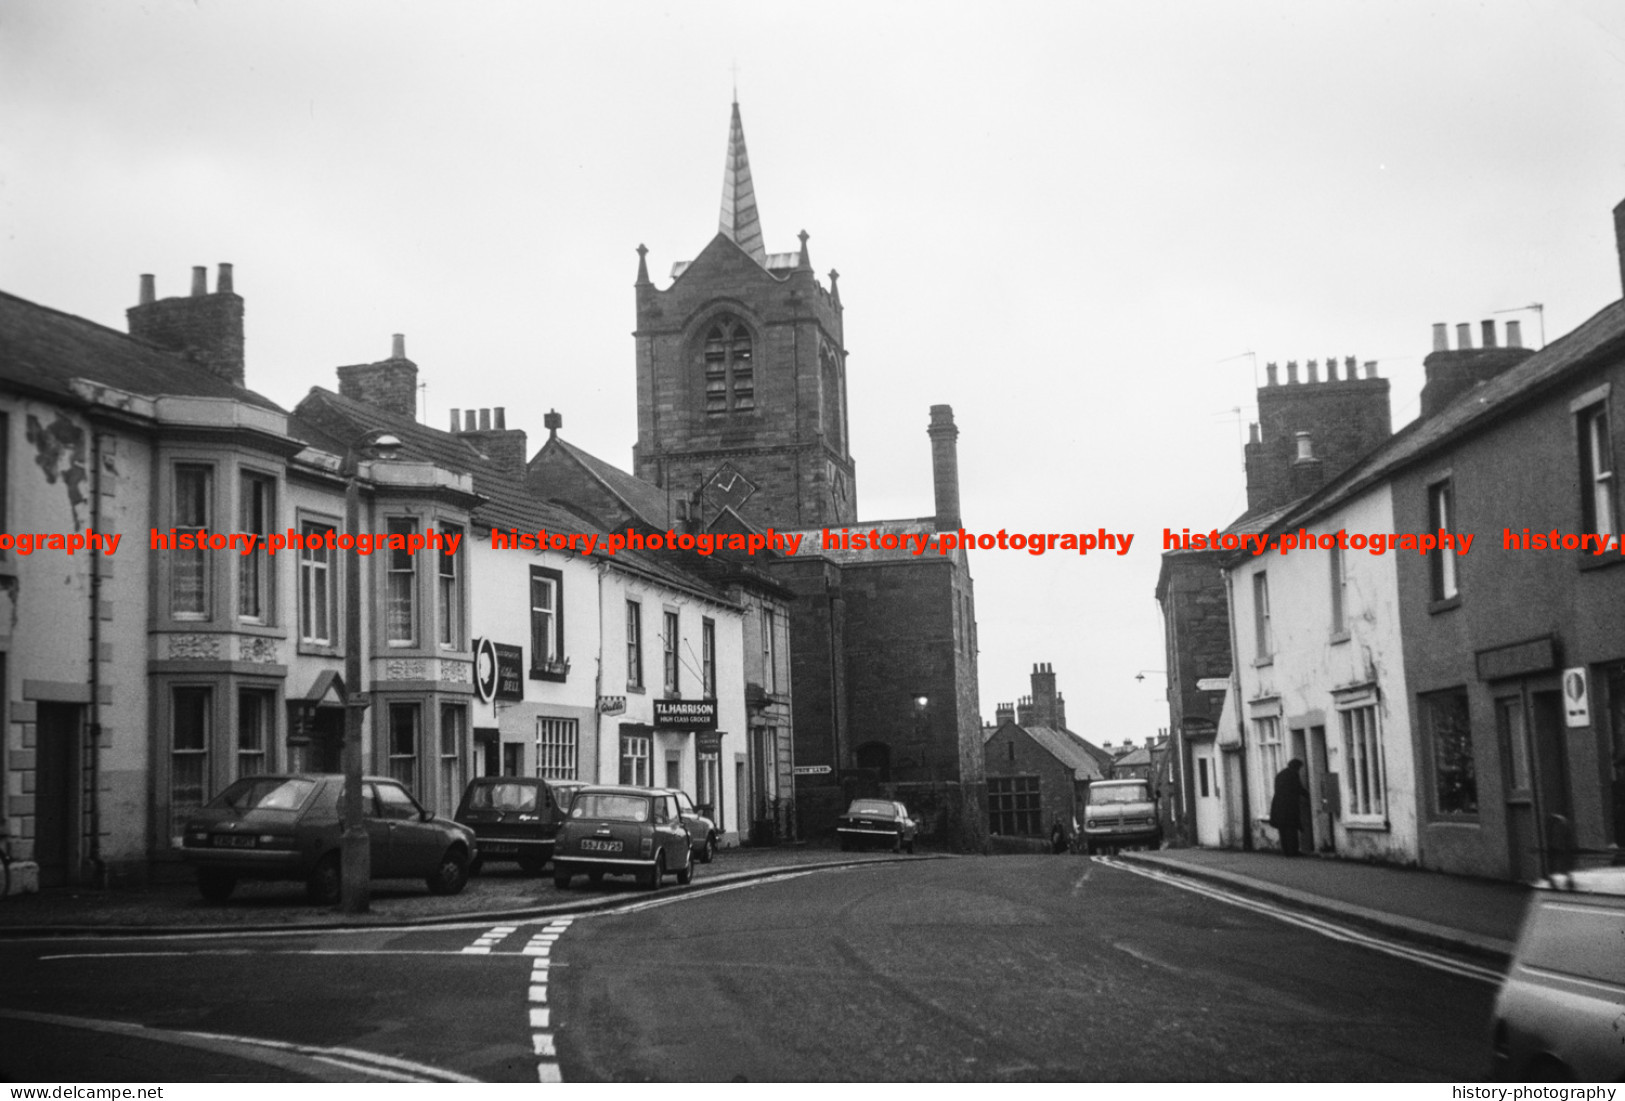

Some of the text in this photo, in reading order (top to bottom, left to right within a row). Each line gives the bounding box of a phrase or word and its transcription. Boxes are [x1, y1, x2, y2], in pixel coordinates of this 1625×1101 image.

[660, 715, 710, 723] HIGH CLASS GROCER
